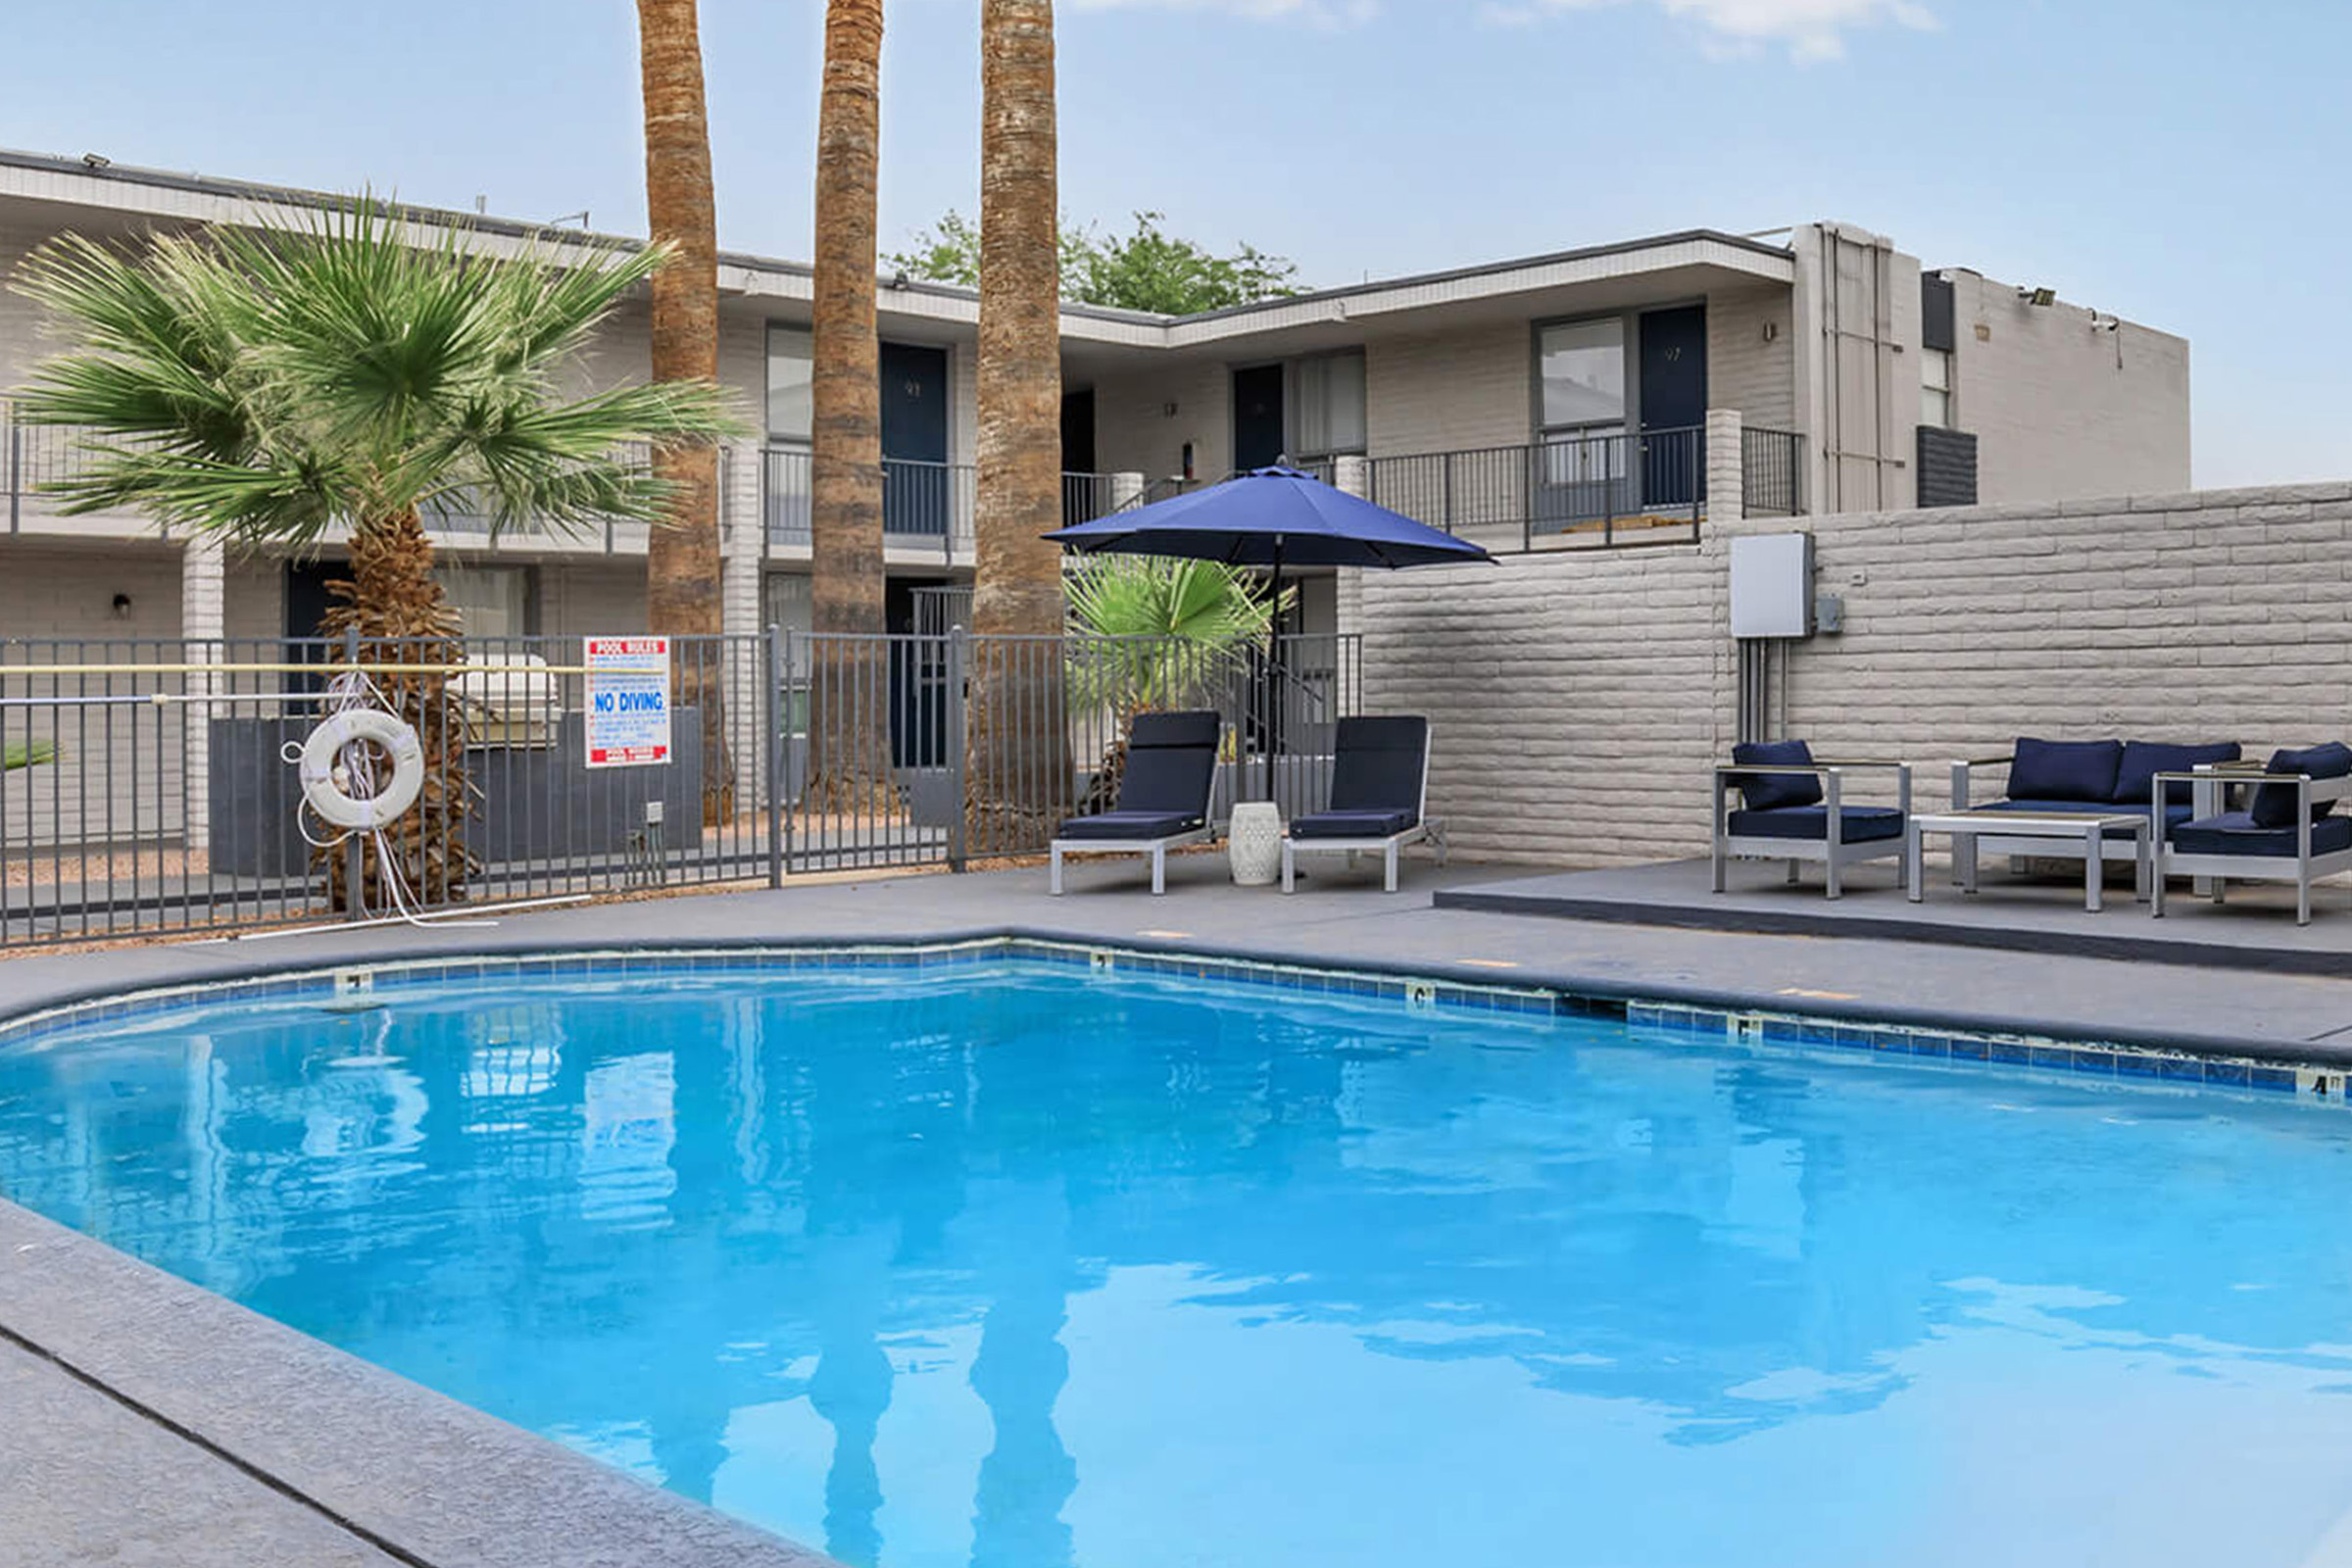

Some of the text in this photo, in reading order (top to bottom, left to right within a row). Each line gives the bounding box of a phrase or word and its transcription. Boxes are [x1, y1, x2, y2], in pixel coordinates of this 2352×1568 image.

[596, 640, 621, 654] POOL
[595, 691, 662, 711] NO DIVING
